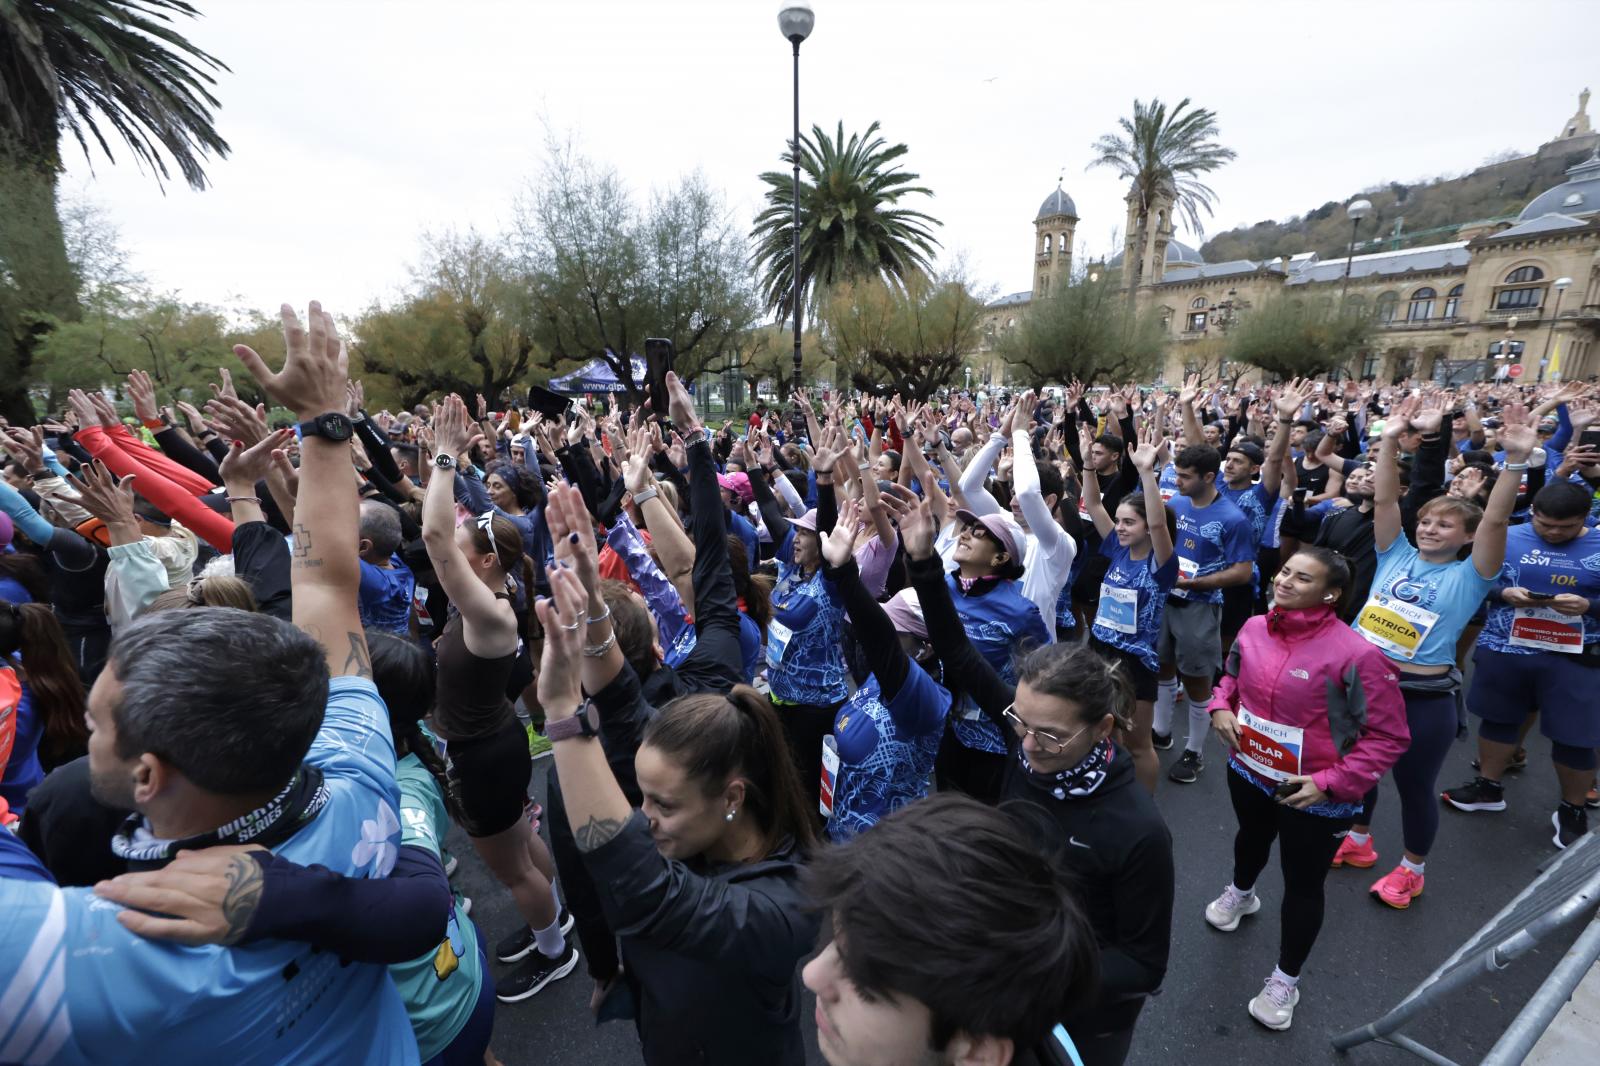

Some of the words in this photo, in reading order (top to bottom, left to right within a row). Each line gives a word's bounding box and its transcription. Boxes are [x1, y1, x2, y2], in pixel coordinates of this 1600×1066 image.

[1550, 574, 1578, 587] 10k
[1389, 603, 1421, 619] ZURICH
[1369, 613, 1417, 639] PATRICIA
[1373, 626, 1394, 639] 12757
[1253, 721, 1288, 739] ZURICH
[1249, 738, 1283, 760] PILAR
[1251, 751, 1274, 767] 10919
[238, 804, 283, 842] SERIES
